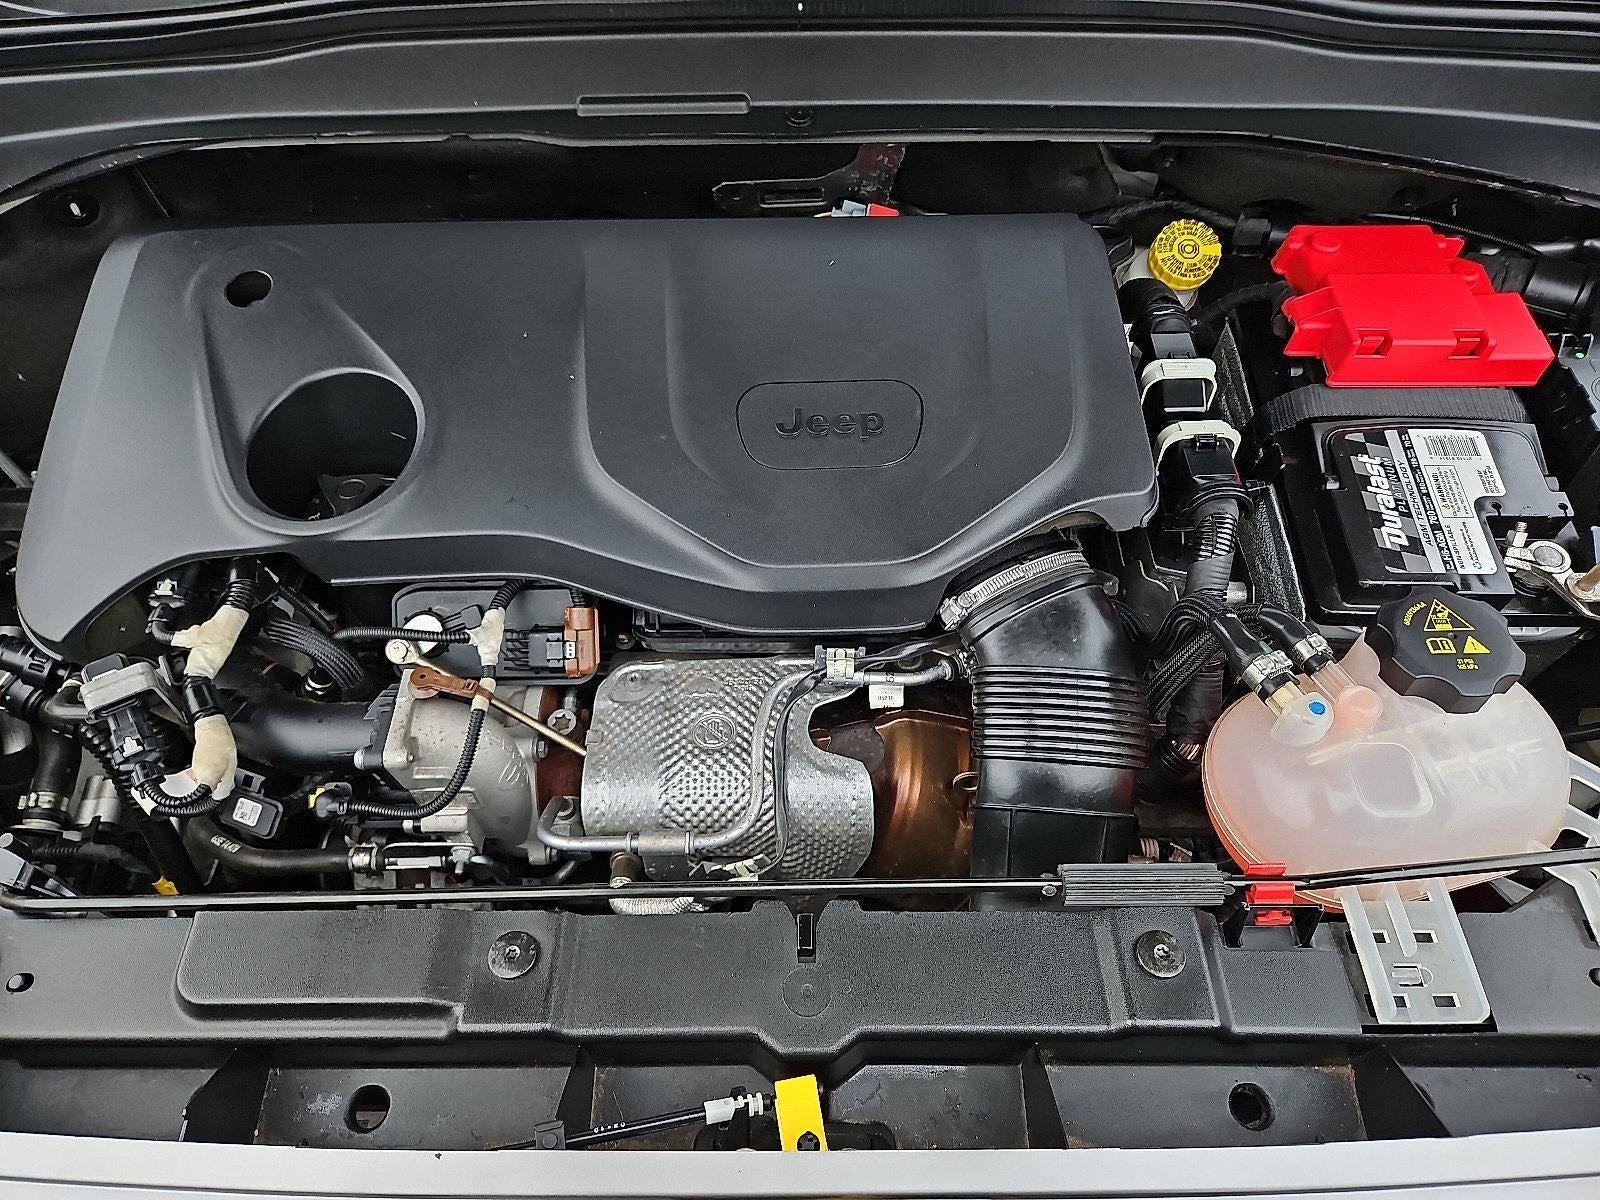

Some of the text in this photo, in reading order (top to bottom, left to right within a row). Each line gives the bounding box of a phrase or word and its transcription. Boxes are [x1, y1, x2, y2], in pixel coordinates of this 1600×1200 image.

[775, 407, 885, 440] Jeep
[1357, 454, 1409, 549] Duralast
[1381, 457, 1409, 512] PLATINUM
[1397, 460, 1424, 521] TECHNOLOGY
[1419, 524, 1433, 547] AGM
[1434, 530, 1452, 561] H6-AGM
